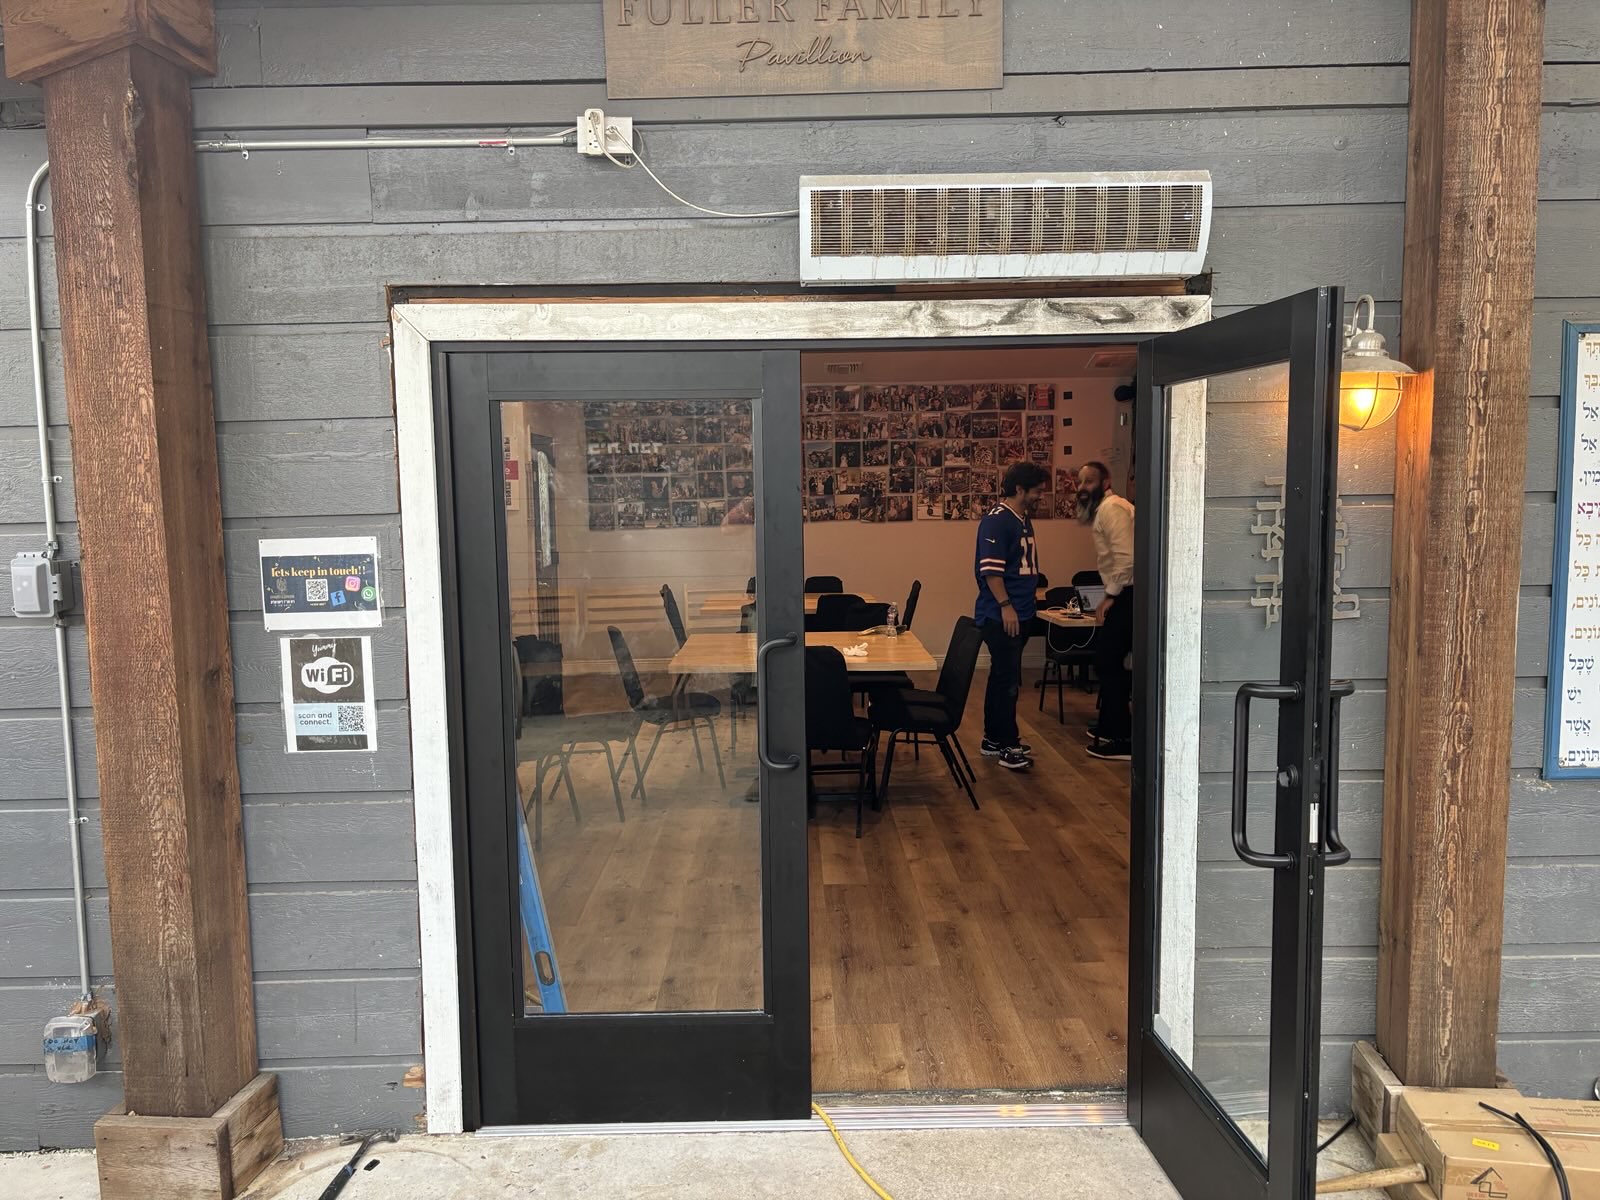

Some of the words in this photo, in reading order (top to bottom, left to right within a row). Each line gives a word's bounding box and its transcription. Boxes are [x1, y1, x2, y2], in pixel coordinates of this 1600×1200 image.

[617, 0, 795, 26] FULLER
[736, 35, 872, 72] Pavillion
[1019, 536, 1038, 575] 17
[271, 567, 290, 577] lets
[291, 566, 316, 579] keep
[317, 566, 328, 576] in
